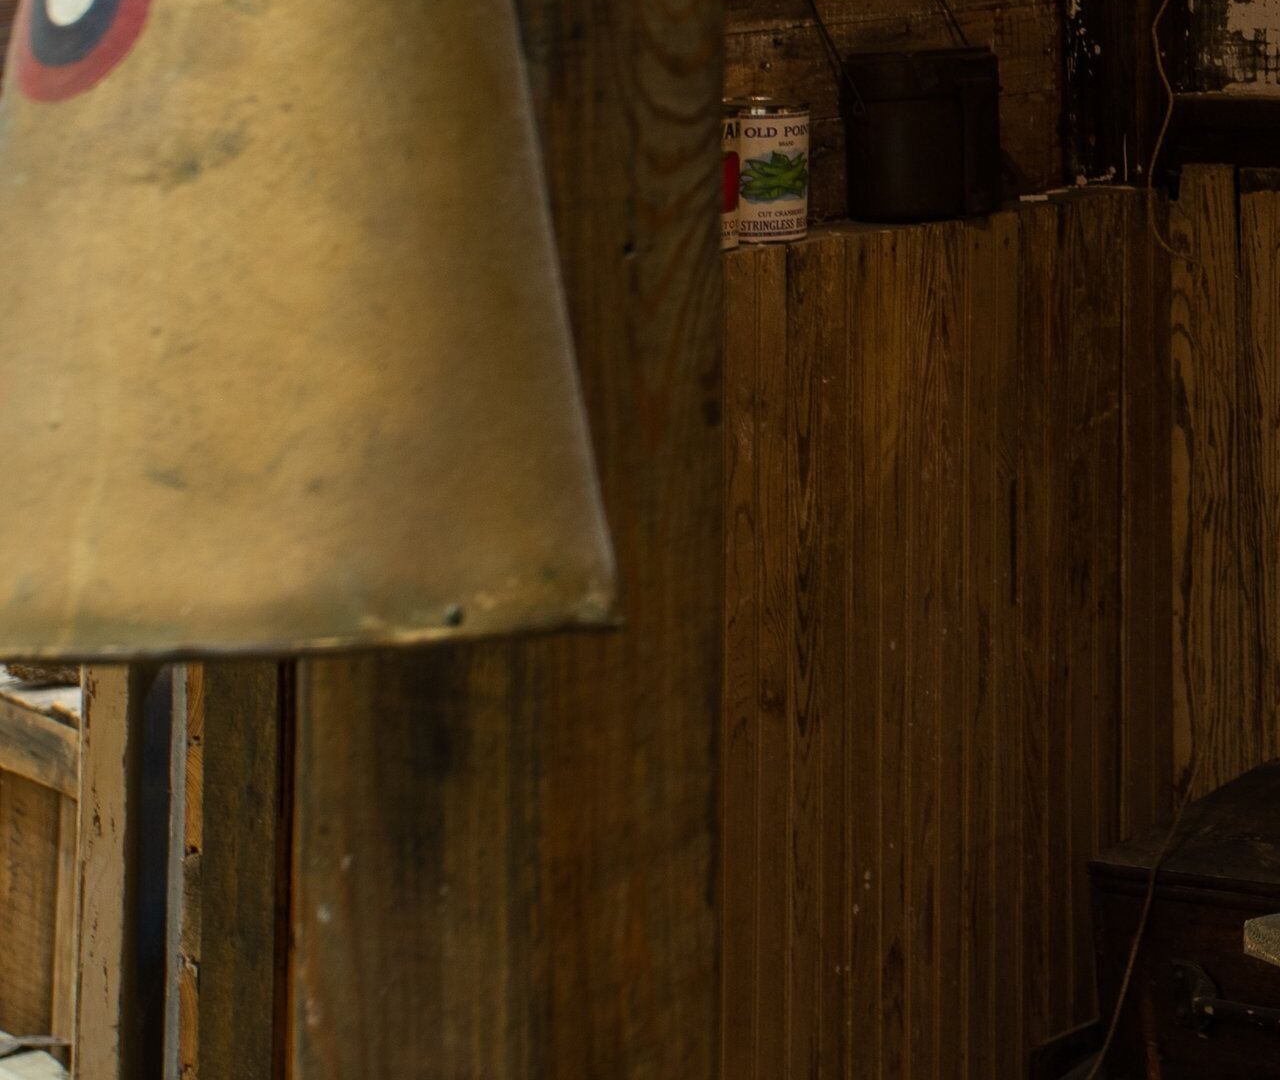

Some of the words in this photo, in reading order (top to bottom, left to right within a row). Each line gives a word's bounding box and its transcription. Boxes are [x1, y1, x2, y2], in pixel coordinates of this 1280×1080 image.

[744, 126, 778, 139] OLD
[758, 211, 773, 219] CUT
[741, 218, 795, 232] STRINGLESS
